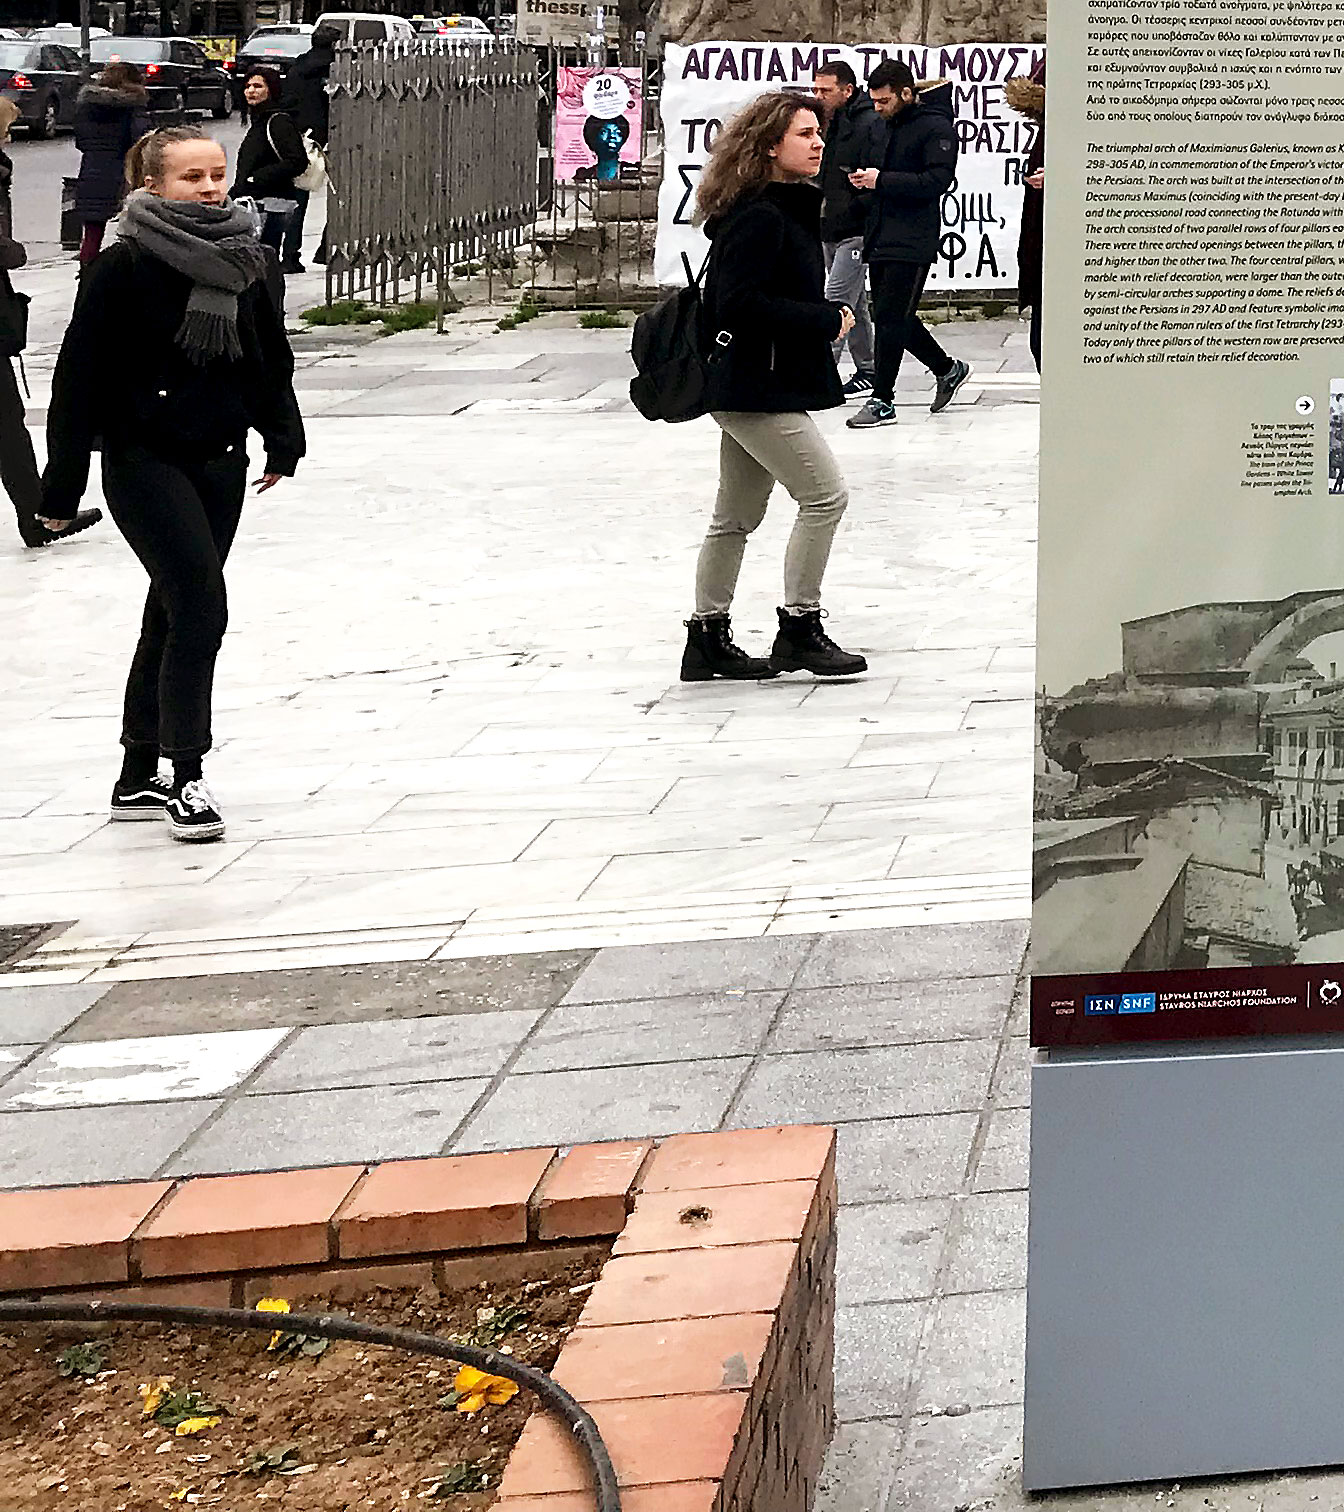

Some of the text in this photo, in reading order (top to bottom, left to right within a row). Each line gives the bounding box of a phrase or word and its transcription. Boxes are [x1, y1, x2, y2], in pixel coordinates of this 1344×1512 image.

[1088, 142, 1103, 153] The
[1106, 141, 1153, 155] triumphal
[1154, 142, 1175, 153] arch
[1178, 142, 1189, 154] of
[1190, 143, 1248, 154] Maximianus
[1250, 142, 1290, 155] Galerius,
[1293, 143, 1323, 154] known
[1326, 145, 1336, 154] as
[1086, 159, 1128, 170] 298-305
[1130, 159, 1146, 171] AD,
[1149, 159, 1158, 169] in
[1160, 160, 1238, 170] commemoration
[1240, 158, 1252, 169] of
[1253, 158, 1268, 170] the
[1270, 158, 1315, 172] Emperor's
[1087, 175, 1102, 186] the
[1149, 174, 1164, 186] The
[1166, 175, 1187, 186] arch
[1191, 176, 1208, 186] was
[1211, 175, 1233, 186] built
[1235, 176, 1245, 186] at
[1248, 175, 1263, 186] the
[1265, 174, 1320, 186] intersection
[1322, 174, 1333, 185] of
[1086, 191, 1141, 202] Decumanus
[1143, 190, 1186, 202] Maximus
[1189, 190, 1240, 204] (coinciding
[1243, 191, 1264, 201] with
[1267, 191, 1282, 202] the
[1283, 192, 1340, 204] present-day
[1089, 999, 1115, 1011] ΙΣΝ
[1122, 997, 1152, 1010] SNF
[1159, 996, 1298, 1010] STAVROS NIARCHOS FOUNDATION
